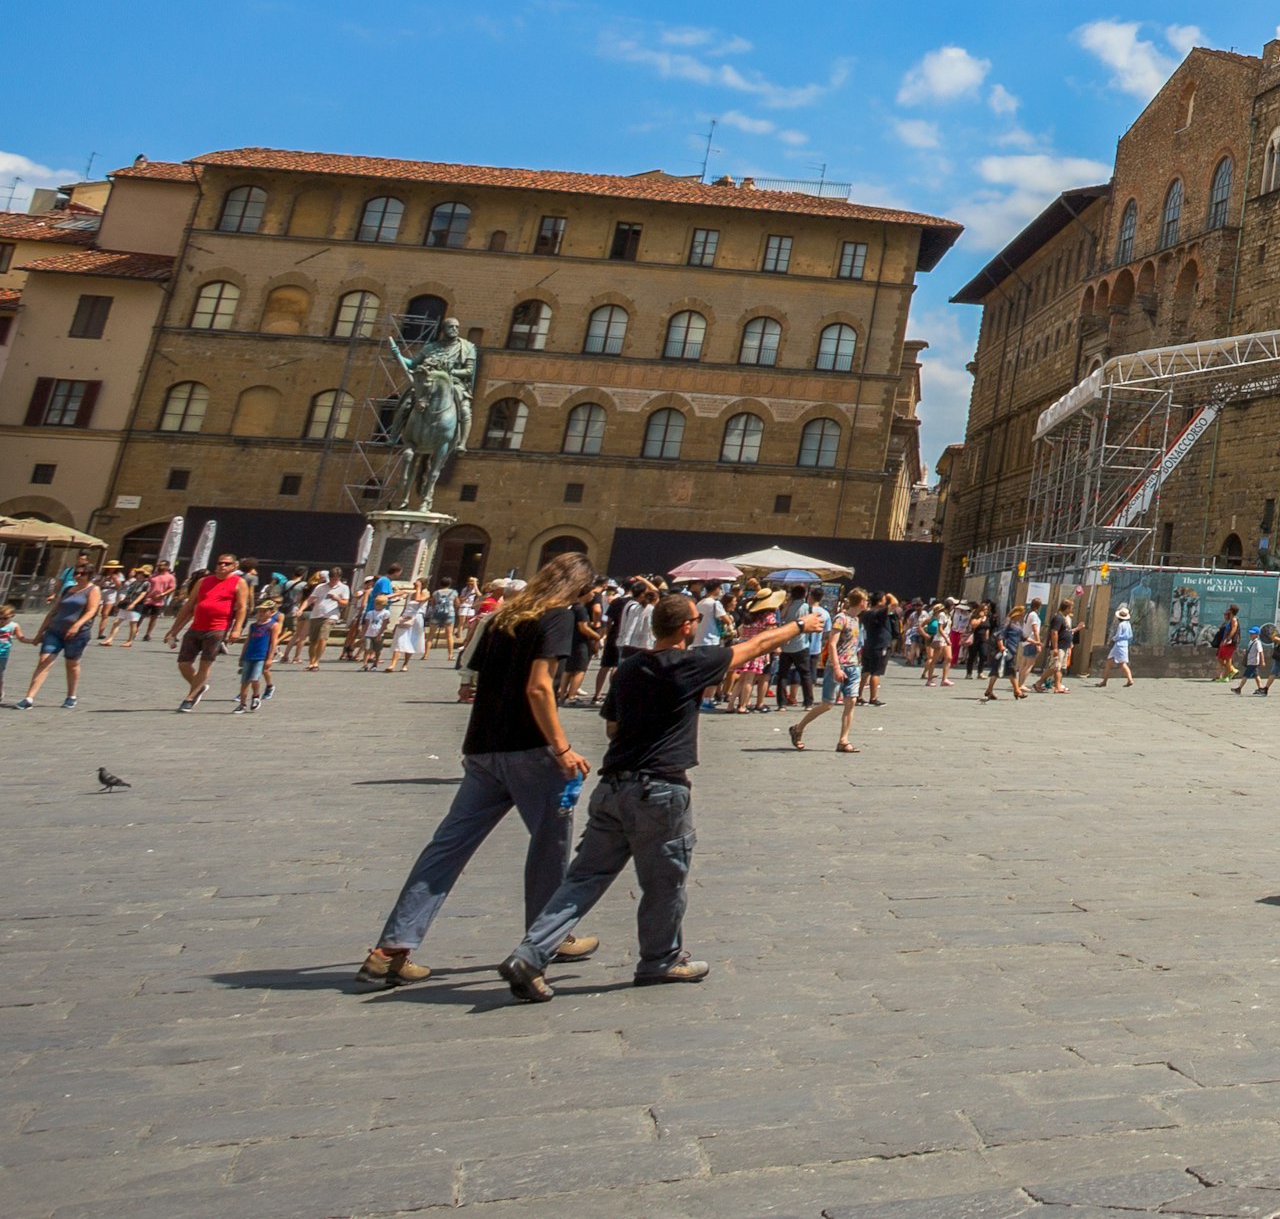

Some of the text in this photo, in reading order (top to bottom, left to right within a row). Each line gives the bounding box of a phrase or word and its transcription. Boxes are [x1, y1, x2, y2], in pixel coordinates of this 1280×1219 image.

[1182, 576, 1244, 586] The FOUNTAIN
[1206, 584, 1258, 593] of NEPTUNE
